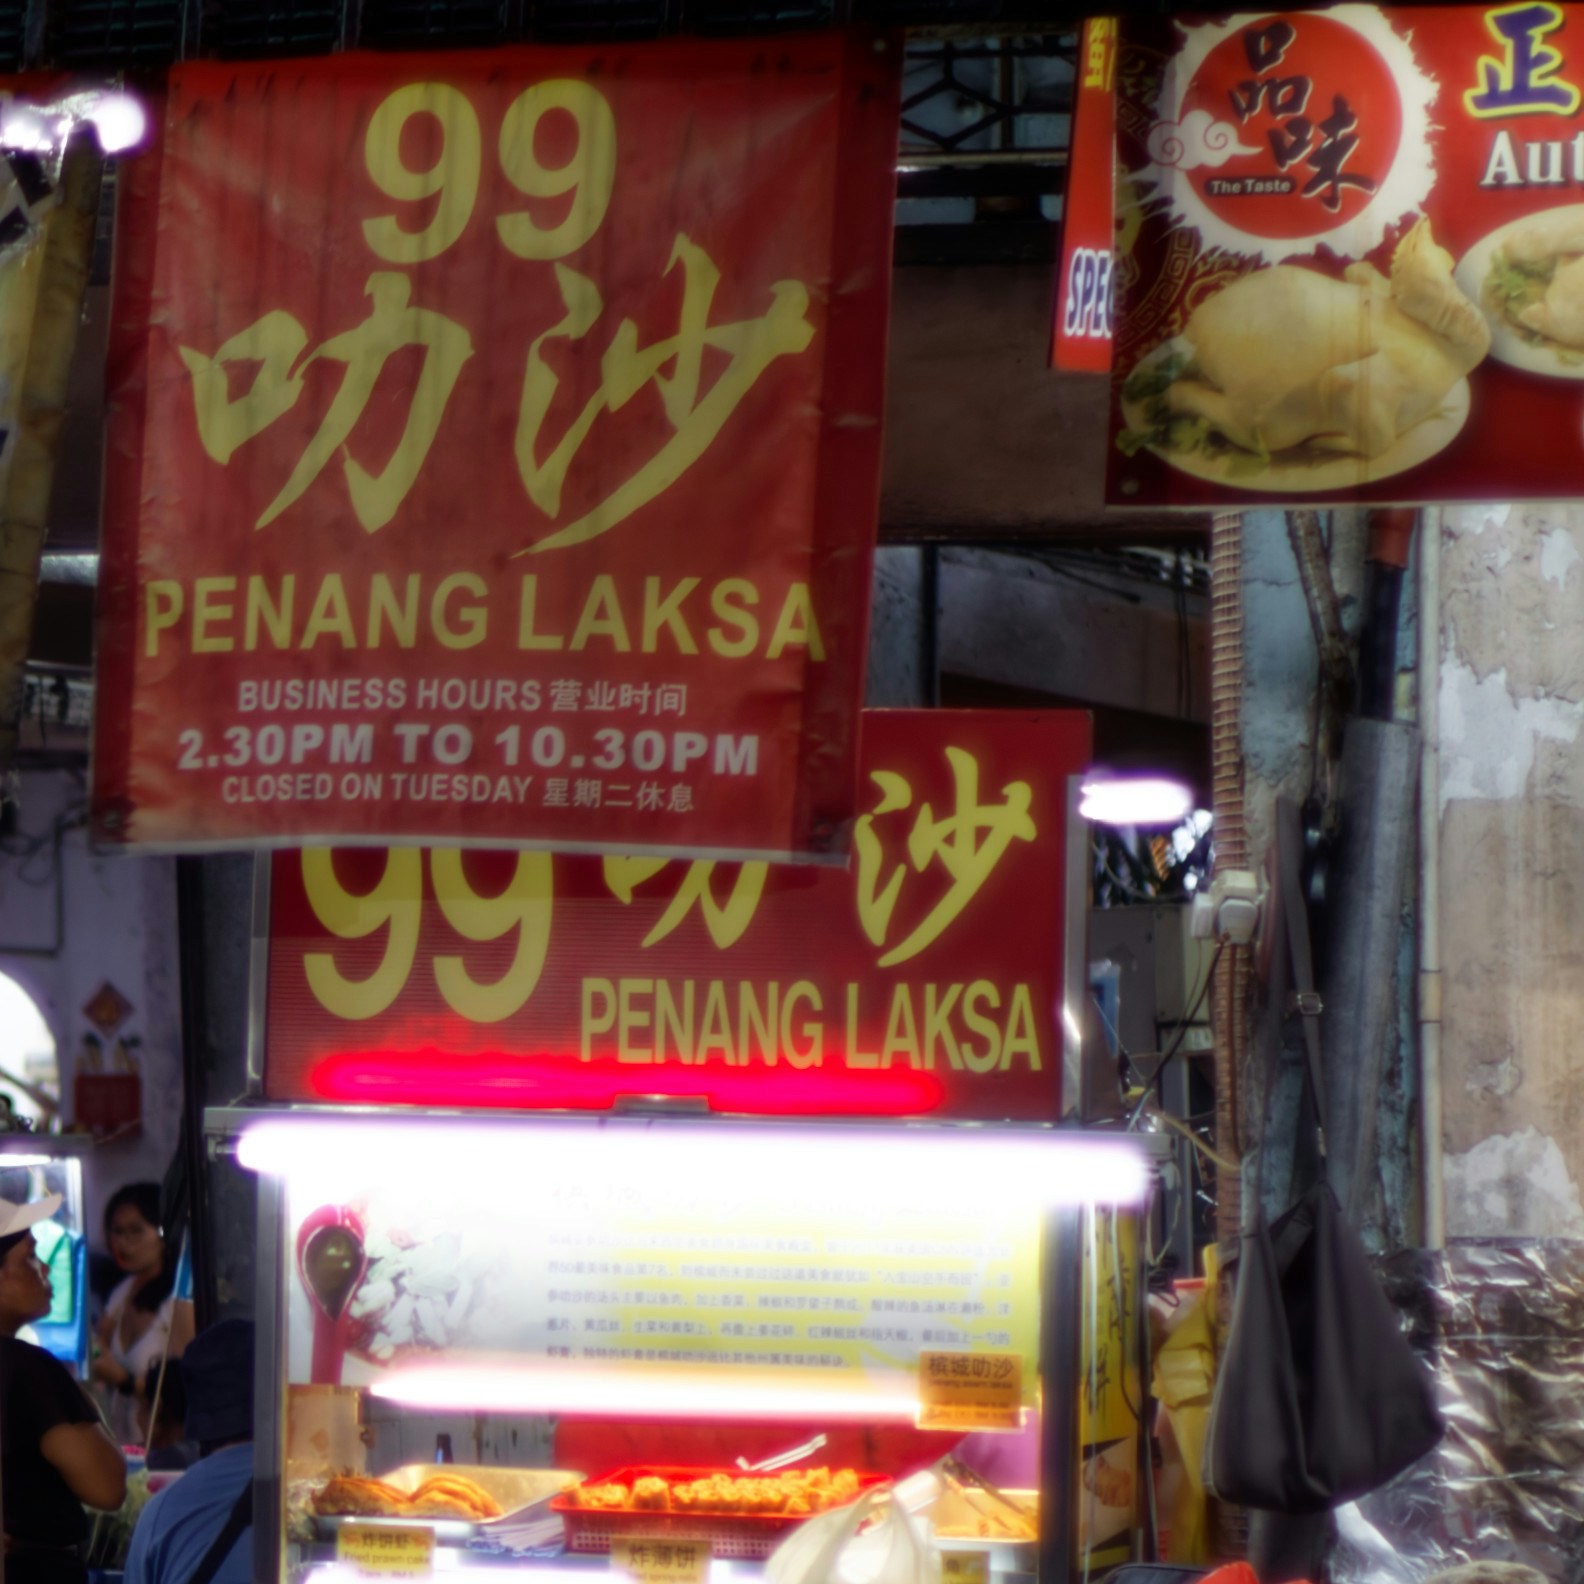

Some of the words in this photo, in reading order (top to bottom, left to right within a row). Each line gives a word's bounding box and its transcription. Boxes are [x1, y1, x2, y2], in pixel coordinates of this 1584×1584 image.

[1228, 20, 1377, 214] 品味
[361, 78, 617, 264] 99
[1210, 178, 1244, 195] The
[1244, 177, 1292, 195] Taste
[177, 231, 816, 560] 叻沙
[145, 572, 489, 657] PENANG
[517, 574, 827, 662] LAKSA
[237, 678, 407, 713] BUSINESS
[416, 678, 542, 713] HOURS
[550, 680, 689, 717] 营业时间
[177, 724, 373, 771] 2.30PM
[394, 724, 473, 765] TO
[493, 726, 760, 776] 10.30PM
[222, 773, 333, 804] CLOSED
[339, 773, 383, 802] ON
[390, 774, 533, 804] TUESDAY
[542, 777, 695, 813] 星期二休息
[300, 845, 555, 1023] 99
[581, 977, 824, 1070] PENANG
[845, 979, 1043, 1073] LAKSA
